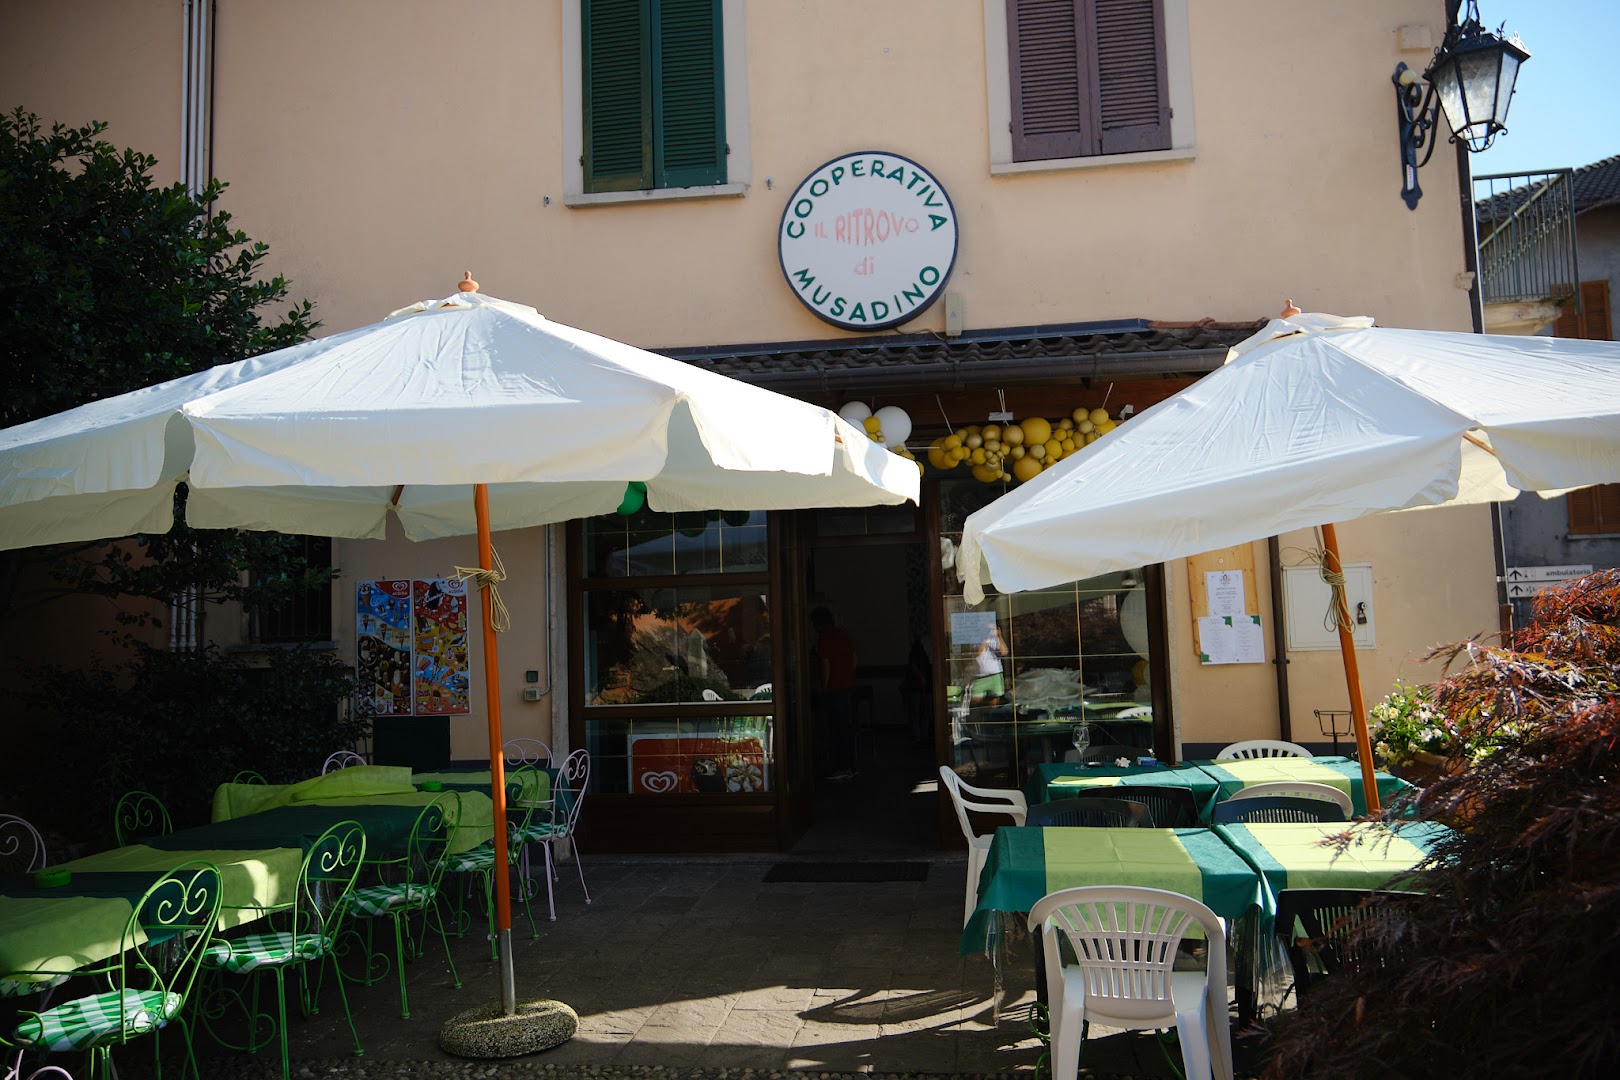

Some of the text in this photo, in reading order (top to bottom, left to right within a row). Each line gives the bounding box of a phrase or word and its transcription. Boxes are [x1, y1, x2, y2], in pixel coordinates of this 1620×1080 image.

[787, 160, 948, 239] COOPERATIVA
[814, 207, 920, 246] IL RITROVO
[853, 256, 875, 275] di
[793, 266, 940, 322] MUSADINO
[1545, 569, 1592, 577] ambulatorio
